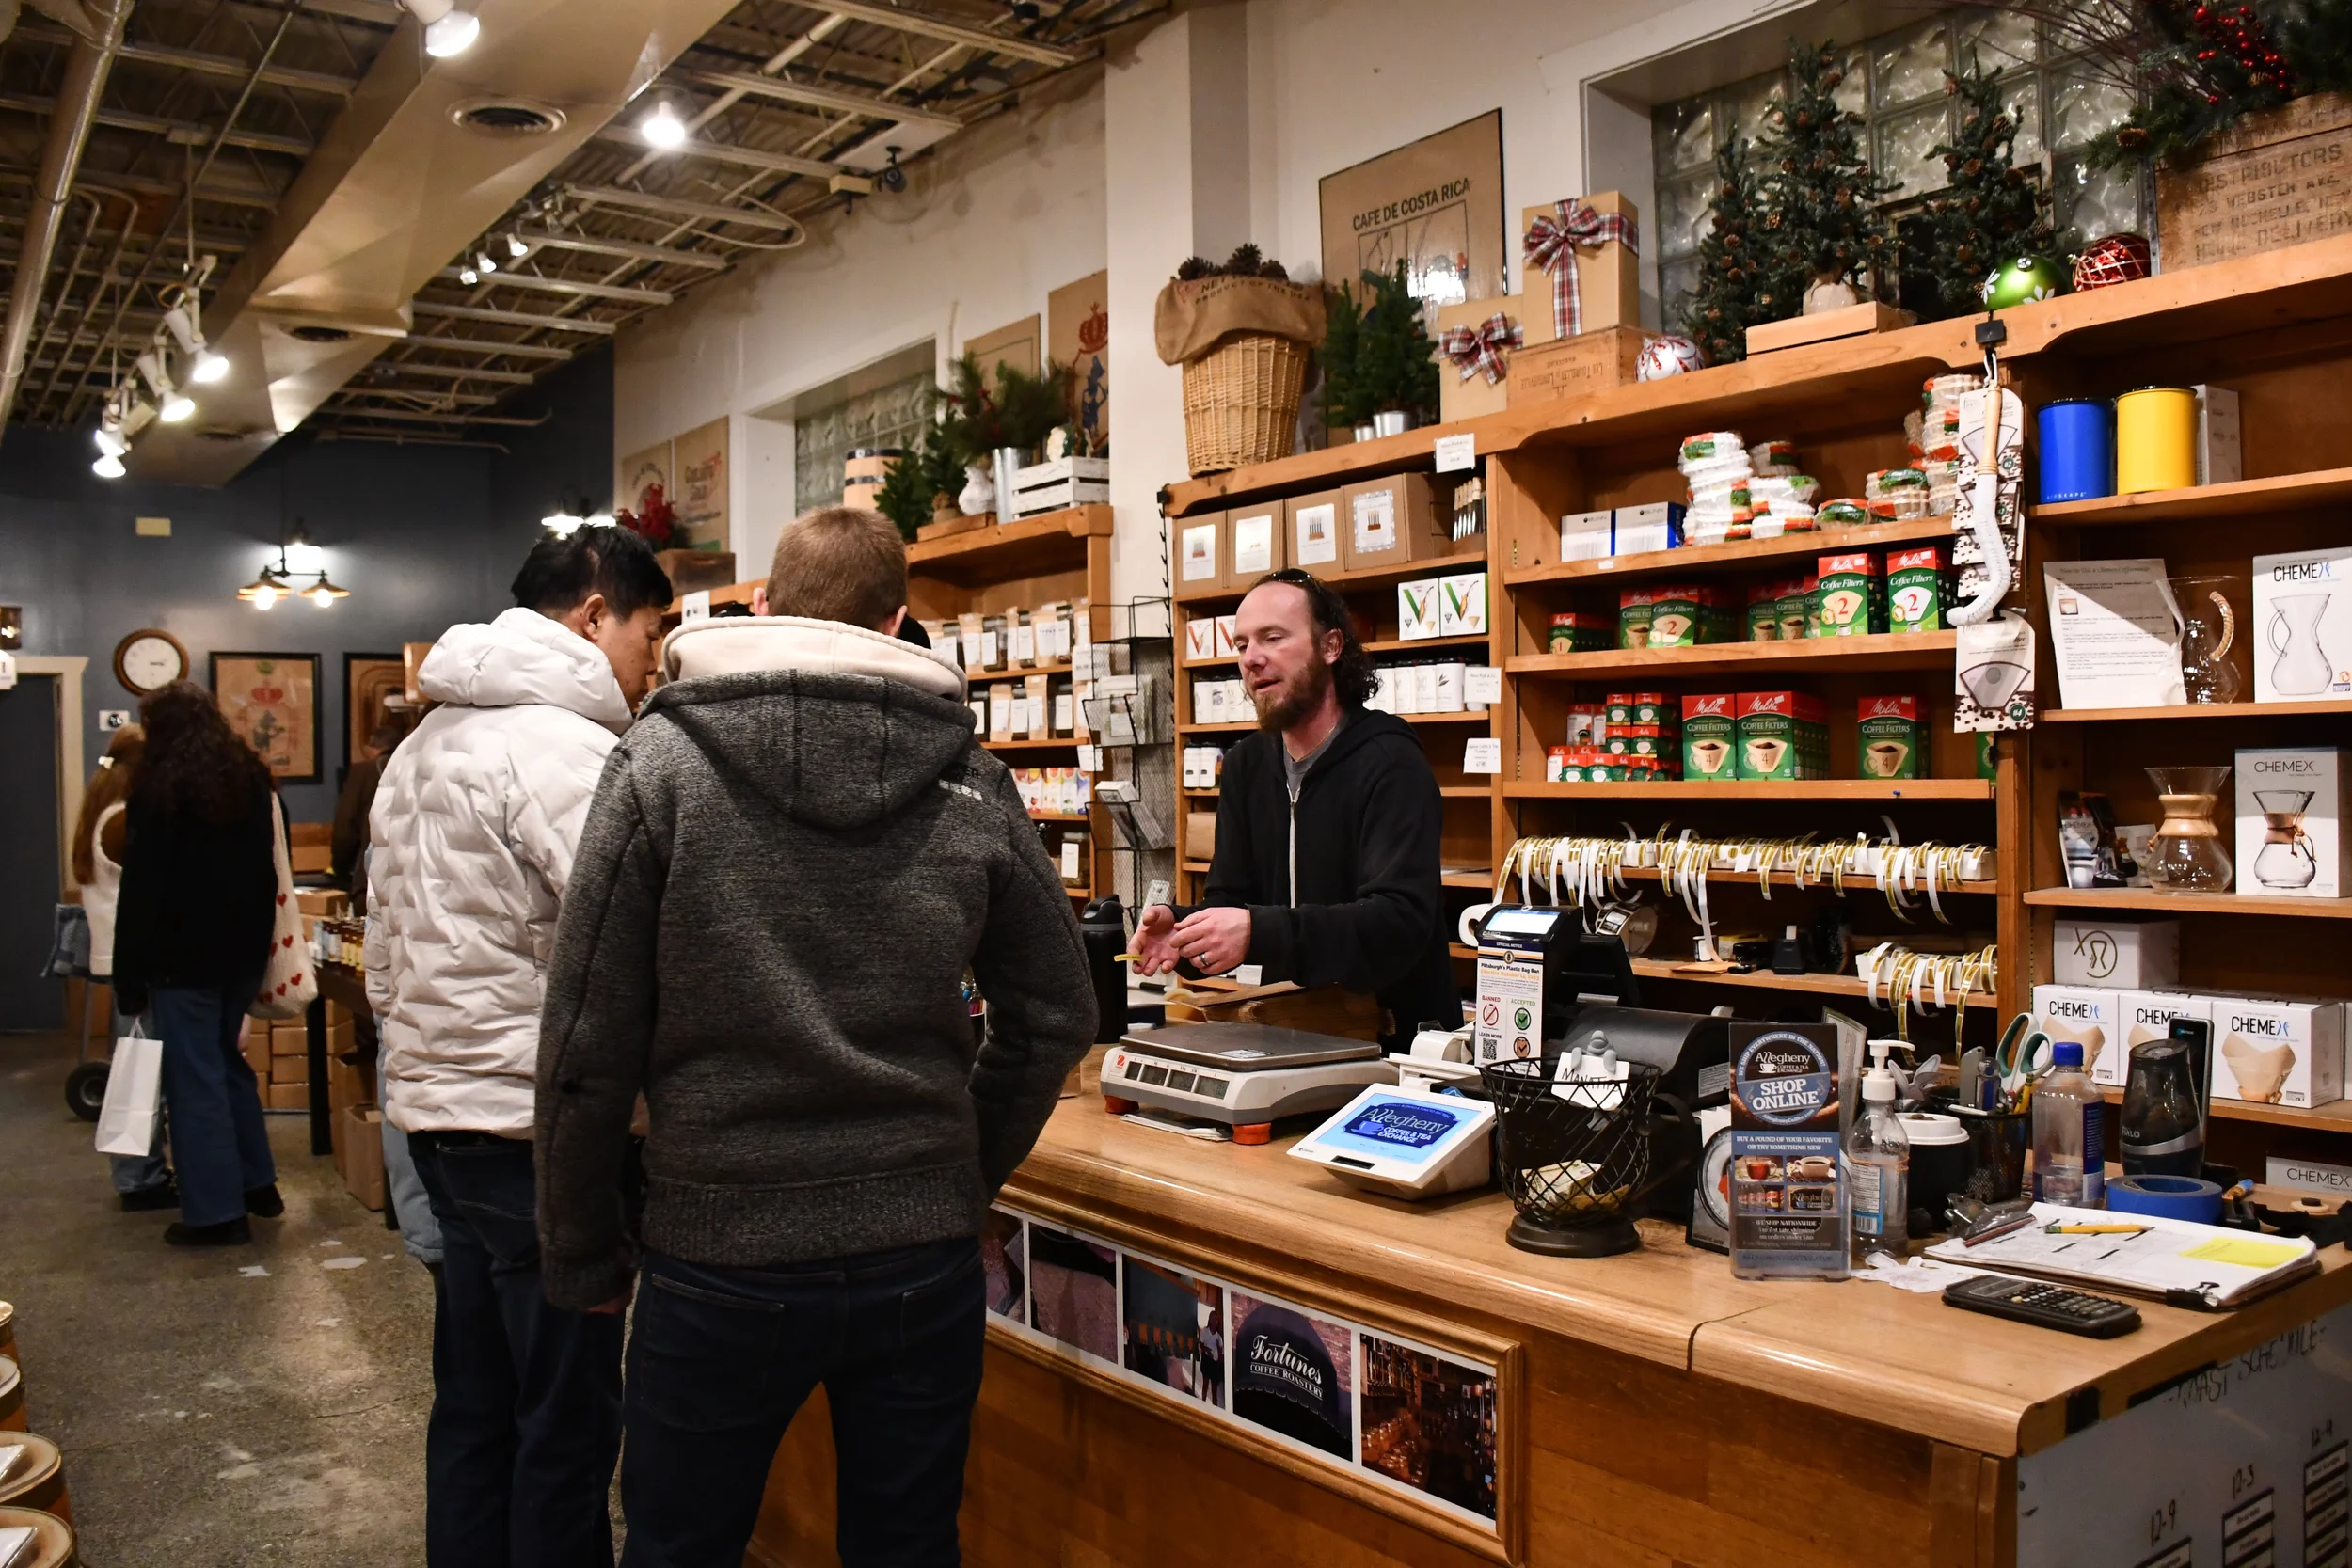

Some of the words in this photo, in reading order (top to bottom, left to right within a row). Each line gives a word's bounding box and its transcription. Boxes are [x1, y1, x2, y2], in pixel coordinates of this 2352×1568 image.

[1353, 208, 1381, 231] CAFE
[1383, 202, 1399, 223] DE
[1401, 189, 1438, 216] COSTA
[1441, 177, 1470, 202] RICA
[1890, 576, 1912, 587] Coffee
[1912, 574, 1934, 584] Filters
[2273, 562, 2330, 582] CHEMEX
[1820, 579, 1842, 591] Coffee
[1842, 578, 1865, 588] Filters
[1653, 605, 1673, 613] Coffee
[1748, 696, 1779, 712] Melitta
[1870, 699, 1900, 715] Melitta
[2254, 760, 2314, 773] CHEMEX
[1481, 962, 1505, 971] Pittsburgh's
[2049, 1000, 2100, 1020] CHEMEX
[2231, 1016, 2289, 1037] CHEMEX
[1750, 1033, 1788, 1054] EVERYWHERE
[1796, 1036, 1809, 1047] THE
[1755, 1051, 1811, 1064] Allegheny
[1760, 1078, 1807, 1096] SHOP
[1752, 1091, 1820, 1111] ONLINE
[1360, 1108, 1450, 1134] Allegheny
[1377, 1131, 1419, 1143] EXCHANGE
[1383, 1127, 1411, 1136] COFFEE
[2287, 1168, 2349, 1187] CHEMEX
[1250, 1335, 1322, 1385] Fortunes
[1250, 1363, 1279, 1376] COFFEE
[1282, 1370, 1323, 1398] ROASTERY
